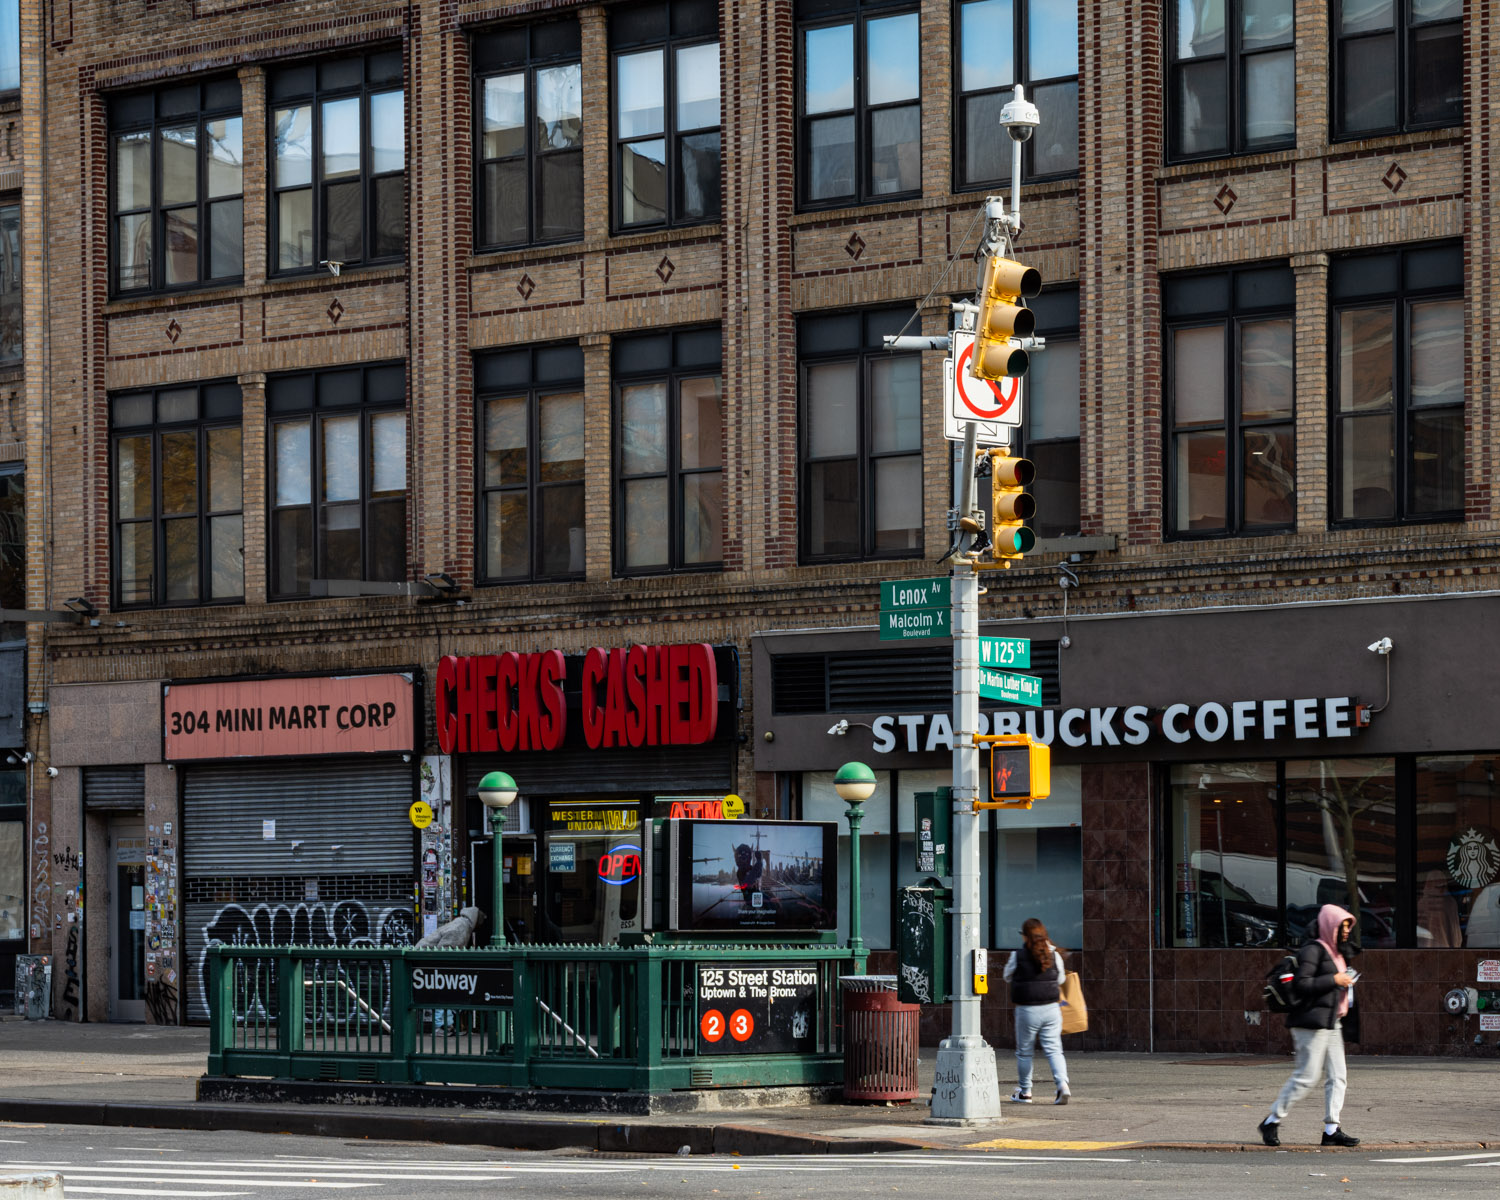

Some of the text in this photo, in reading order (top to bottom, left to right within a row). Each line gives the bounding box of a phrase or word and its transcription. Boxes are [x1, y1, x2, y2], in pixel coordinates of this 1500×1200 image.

[892, 582, 941, 606] Lenox Av
[889, 611, 944, 628] Malcolm X
[903, 628, 931, 638] Boulevard
[982, 641, 1025, 664] W 125 St
[987, 671, 1003, 688] Martin
[1004, 674, 1020, 691] Luther
[1021, 678, 1032, 697] King
[1033, 681, 1039, 695] Jr
[436, 643, 718, 754] CHECKS CASHED
[171, 702, 396, 735] 304 MINI MART CORP
[1161, 697, 1352, 744] COFFEE
[670, 801, 723, 819] ATM
[568, 821, 601, 831] UNION
[413, 968, 478, 995] Subway
[701, 970, 817, 986] 125 Street Station
[701, 986, 796, 1000] Uptown & The Bronx
[708, 1015, 747, 1035] 2 3
